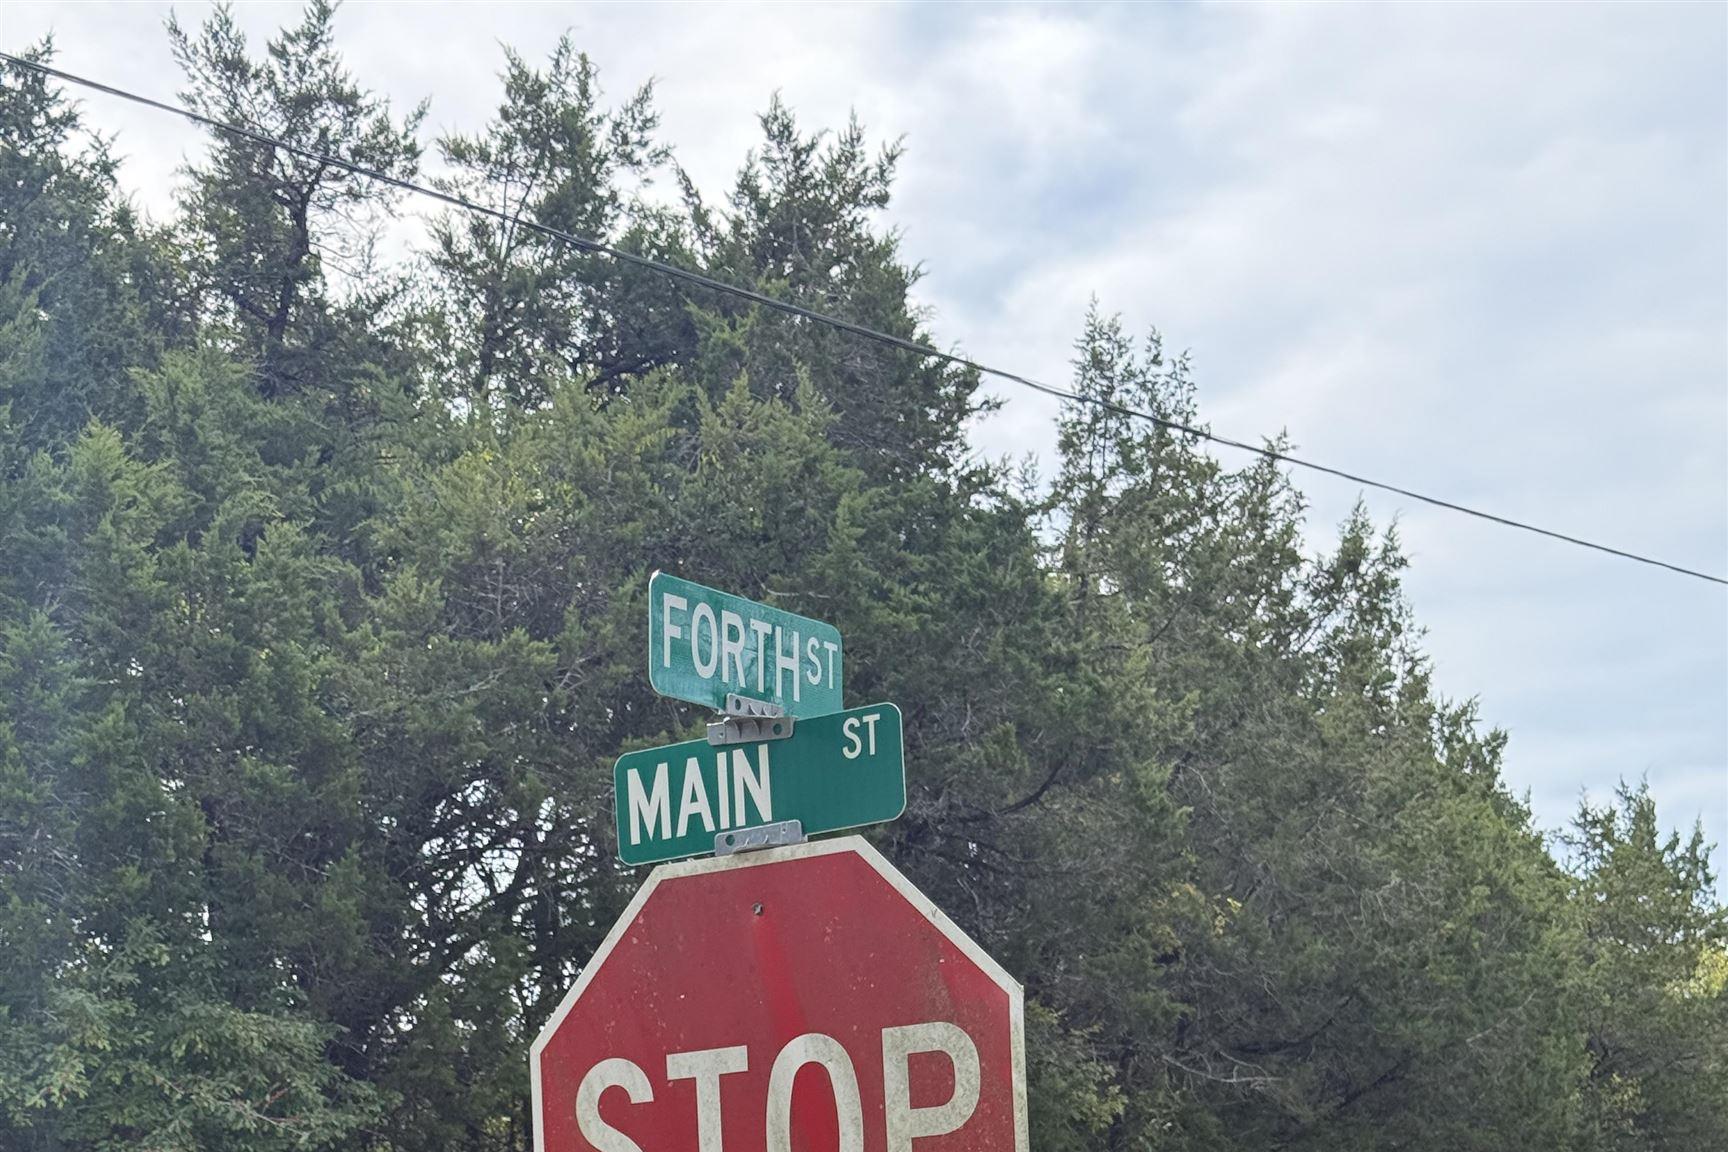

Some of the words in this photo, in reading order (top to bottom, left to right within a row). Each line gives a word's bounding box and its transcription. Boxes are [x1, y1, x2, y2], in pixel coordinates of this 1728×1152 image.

[662, 592, 800, 702] FORTH
[805, 636, 838, 690] ST
[626, 743, 773, 846] MAIN
[841, 713, 881, 760] ST
